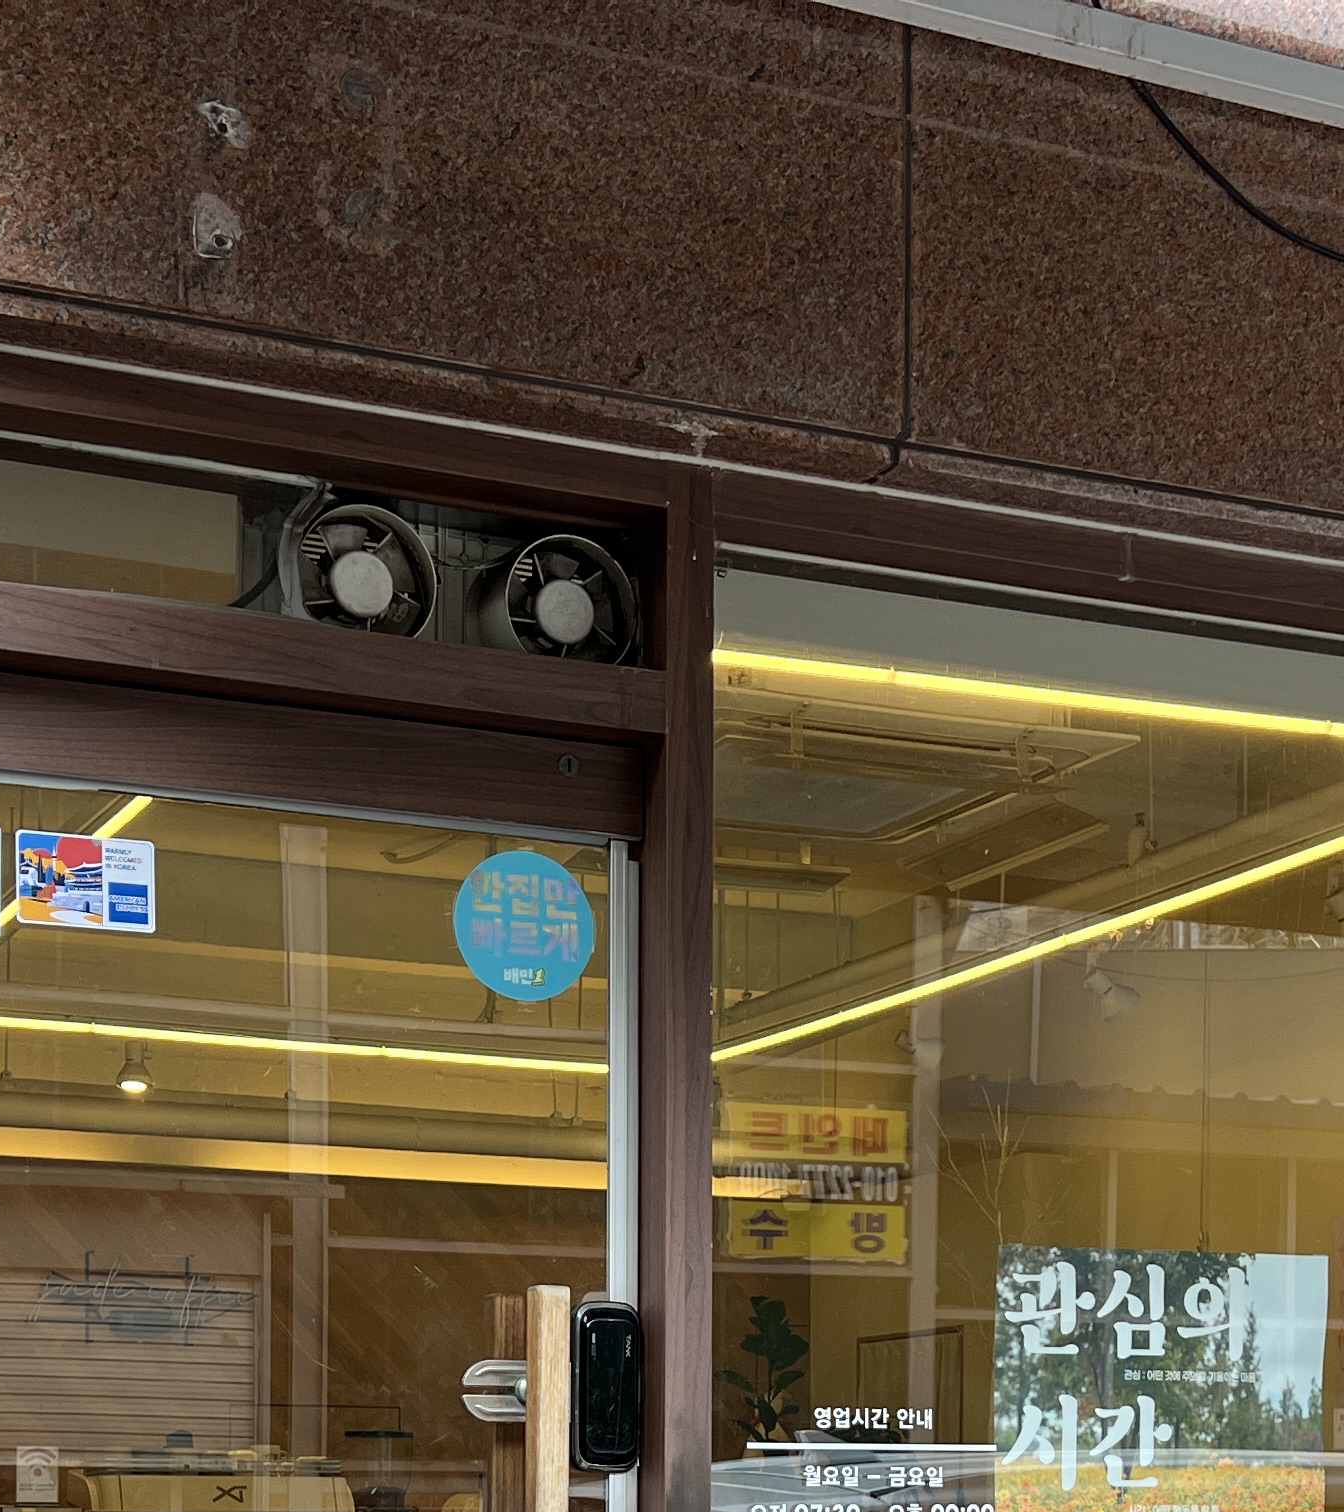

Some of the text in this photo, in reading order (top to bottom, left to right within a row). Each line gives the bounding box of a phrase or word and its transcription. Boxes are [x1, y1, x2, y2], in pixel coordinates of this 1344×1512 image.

[1004, 1261, 1246, 1362] 관심의
[813, 1406, 934, 1430] 영업시간 안내
[1001, 1394, 1173, 1491] 시간
[803, 1465, 860, 1487] 월요일
[888, 1466, 944, 1488] 금요일
